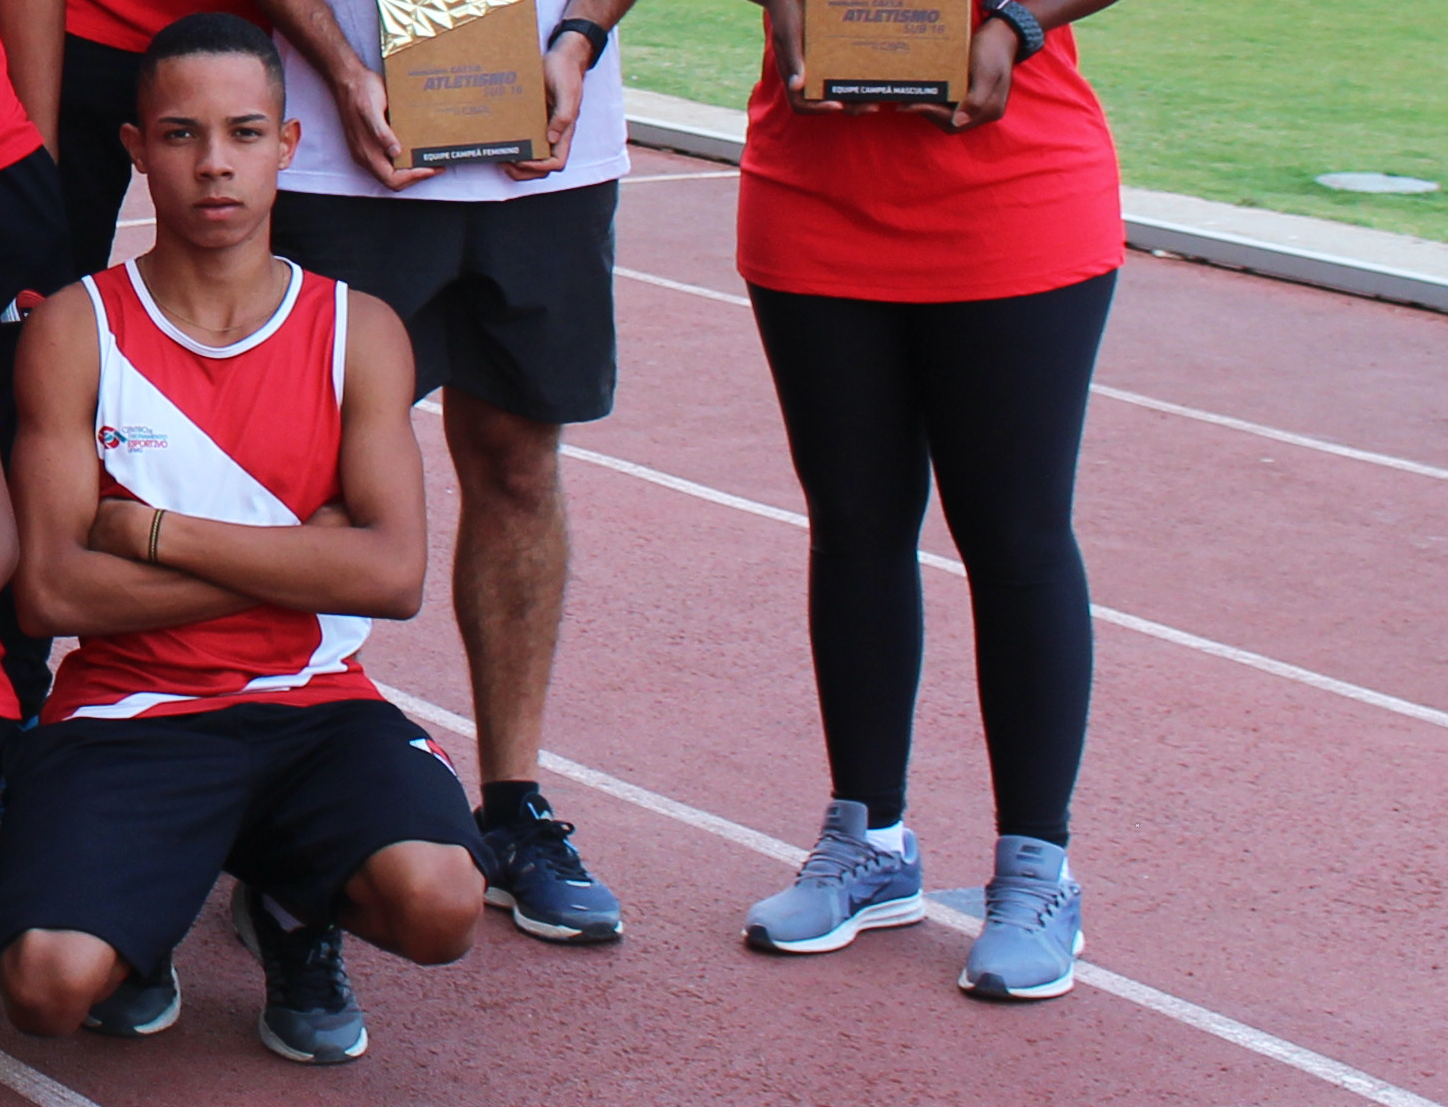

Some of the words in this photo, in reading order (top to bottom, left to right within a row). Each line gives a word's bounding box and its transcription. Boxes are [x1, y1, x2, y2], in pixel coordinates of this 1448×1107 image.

[842, 8, 940, 23] ATLETISMO
[423, 71, 517, 91] ATLETISMO
[831, 85, 860, 95] EQUIPE
[423, 151, 451, 162] EQUIPE
